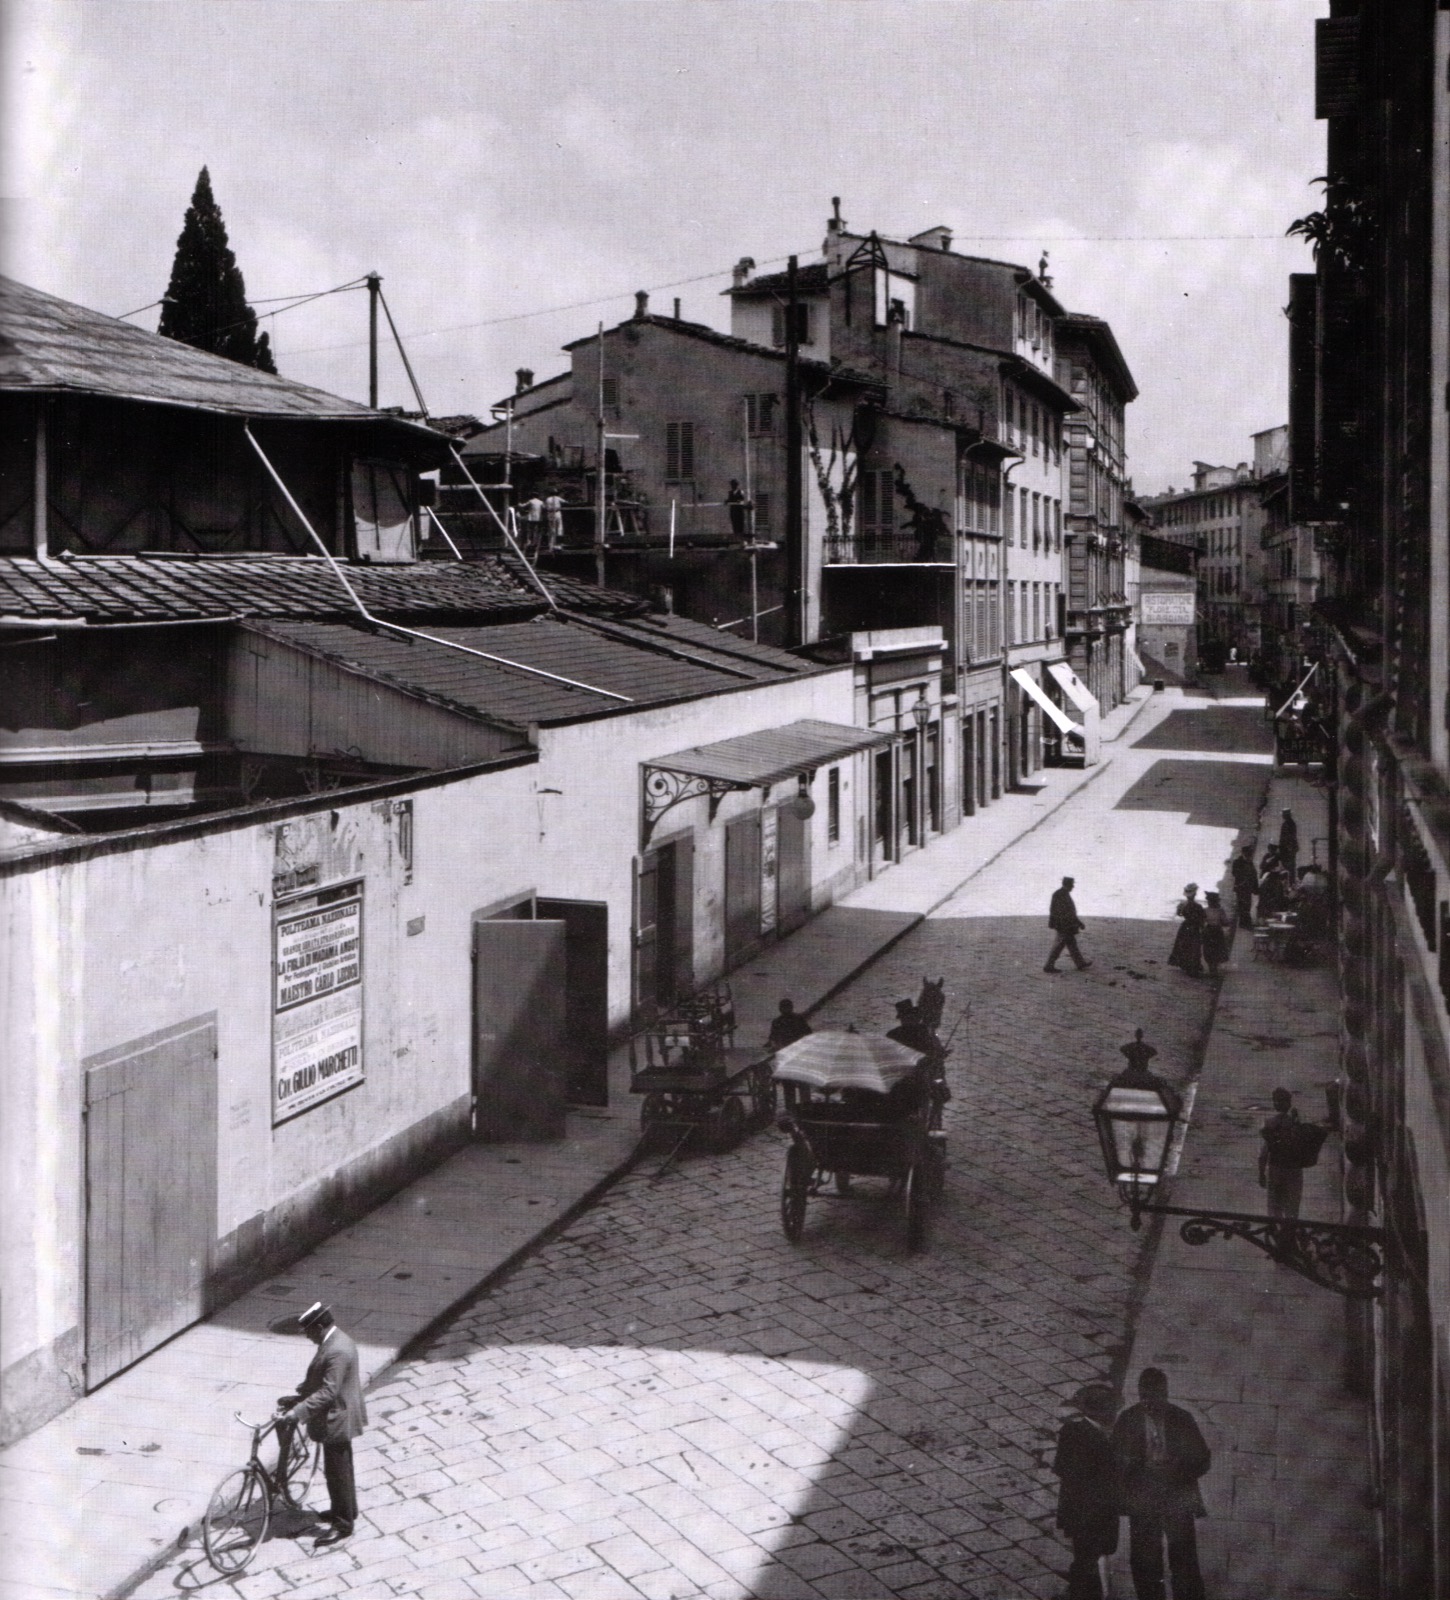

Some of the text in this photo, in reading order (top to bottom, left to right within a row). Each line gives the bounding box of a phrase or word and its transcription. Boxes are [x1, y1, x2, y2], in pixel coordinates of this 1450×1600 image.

[280, 917, 320, 937] POLITEAMA
[321, 905, 358, 925] NAZIONALE
[278, 961, 285, 976] LA
[312, 945, 338, 964] MADAMA
[280, 979, 313, 1006] MAESTRO
[314, 971, 334, 992] CARLO
[293, 1064, 316, 1093] GIULIO
[318, 1045, 357, 1081] MARCHETTI
